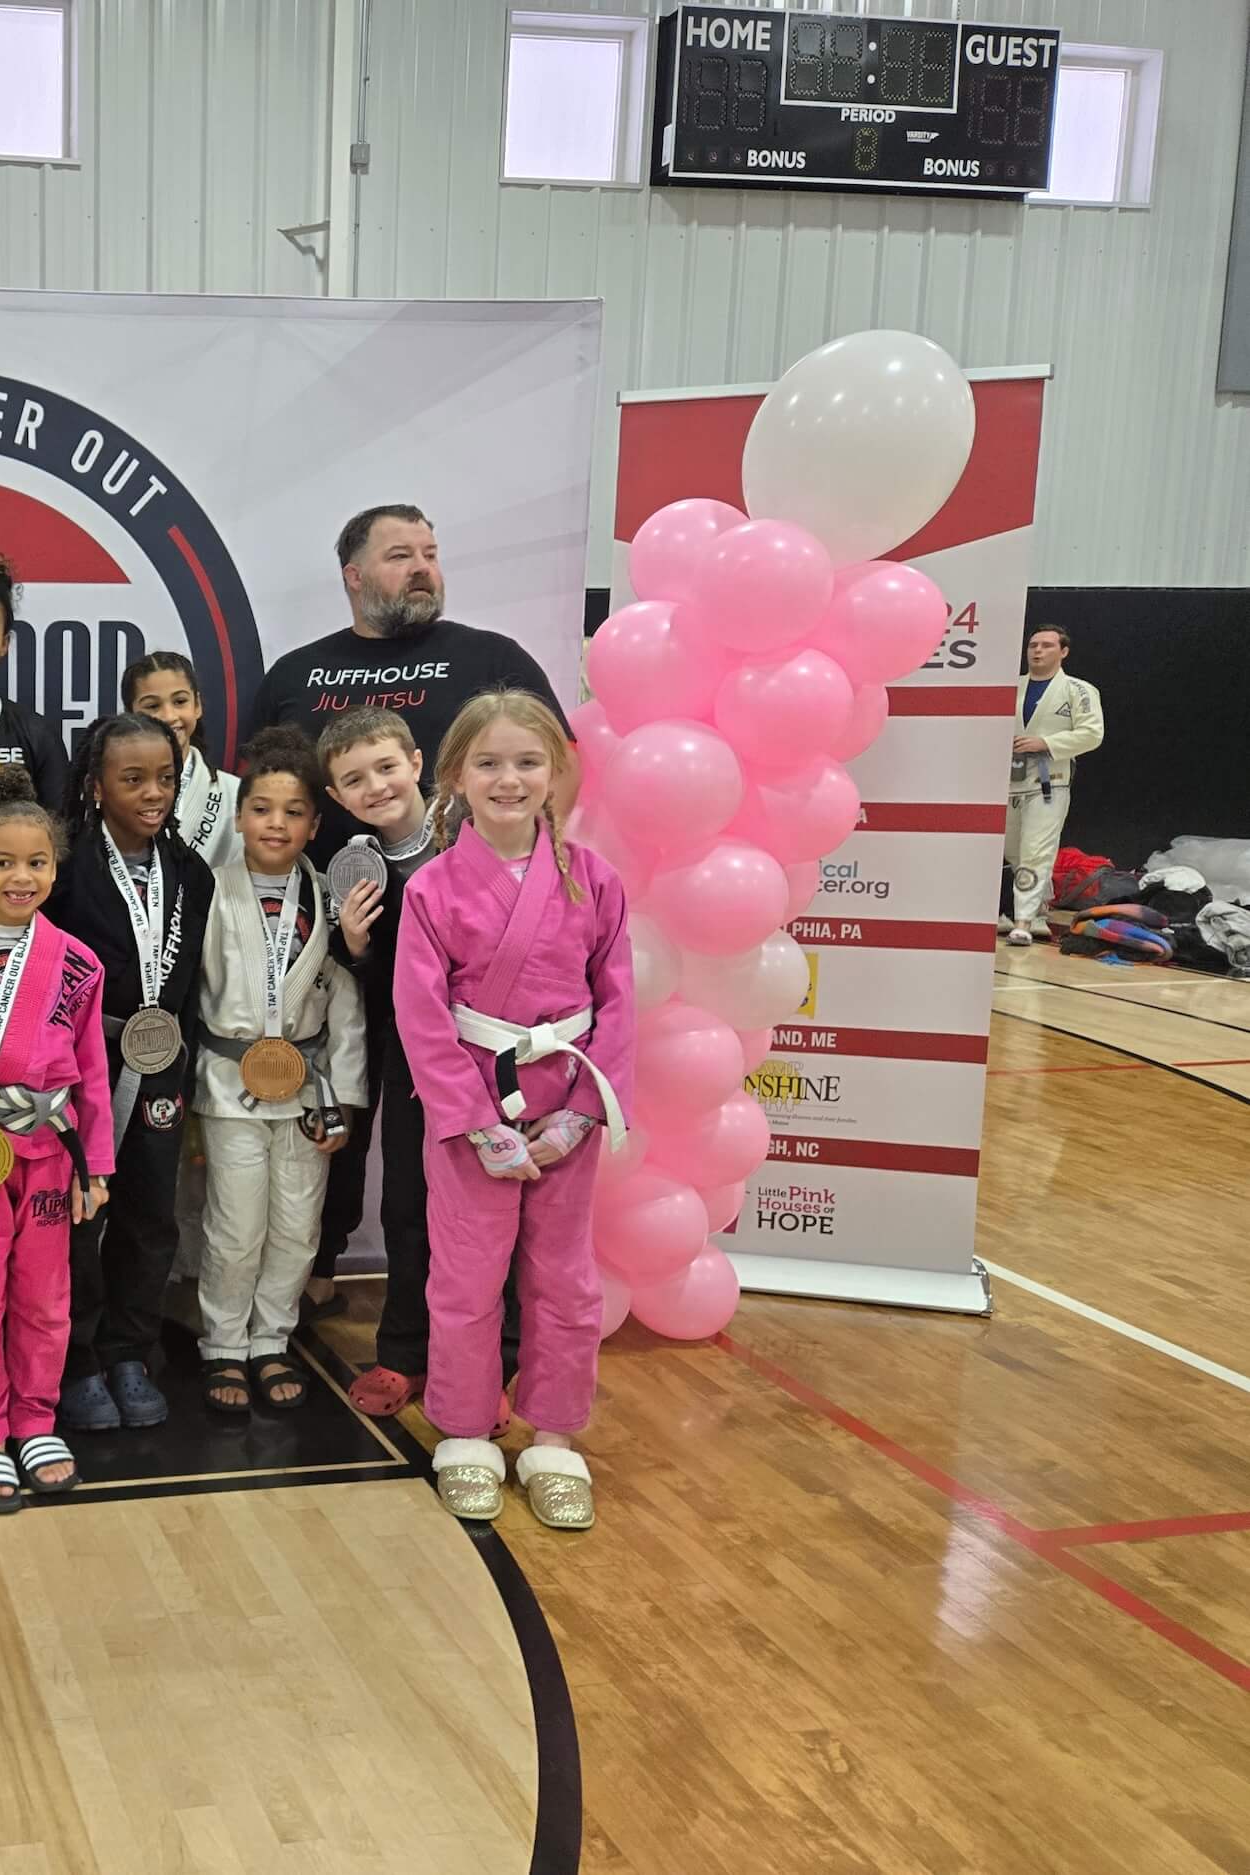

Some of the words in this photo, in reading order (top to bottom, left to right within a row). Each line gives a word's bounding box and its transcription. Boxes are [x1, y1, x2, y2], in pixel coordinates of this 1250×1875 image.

[687, 16, 771, 51] HOME
[965, 35, 1057, 68] GUEST
[840, 108, 896, 124] PERIOD
[748, 150, 806, 169] BONUS
[923, 158, 980, 177] BONUS
[70, 430, 169, 517] OUT
[306, 662, 450, 688] RUFFHOUSE
[311, 691, 350, 712] JIU
[150, 886, 160, 908] OPEN
[840, 923, 863, 940] PA
[9, 959, 23, 978] OUT
[266, 958, 276, 991] CANCER
[268, 992, 276, 1008] TAP
[810, 1032, 838, 1049] ME
[795, 1141, 820, 1158] NC
[758, 1186, 787, 1199] Little
[788, 1185, 836, 1205] Pink
[757, 1197, 822, 1215] Houses
[756, 1210, 834, 1236] HOPE
